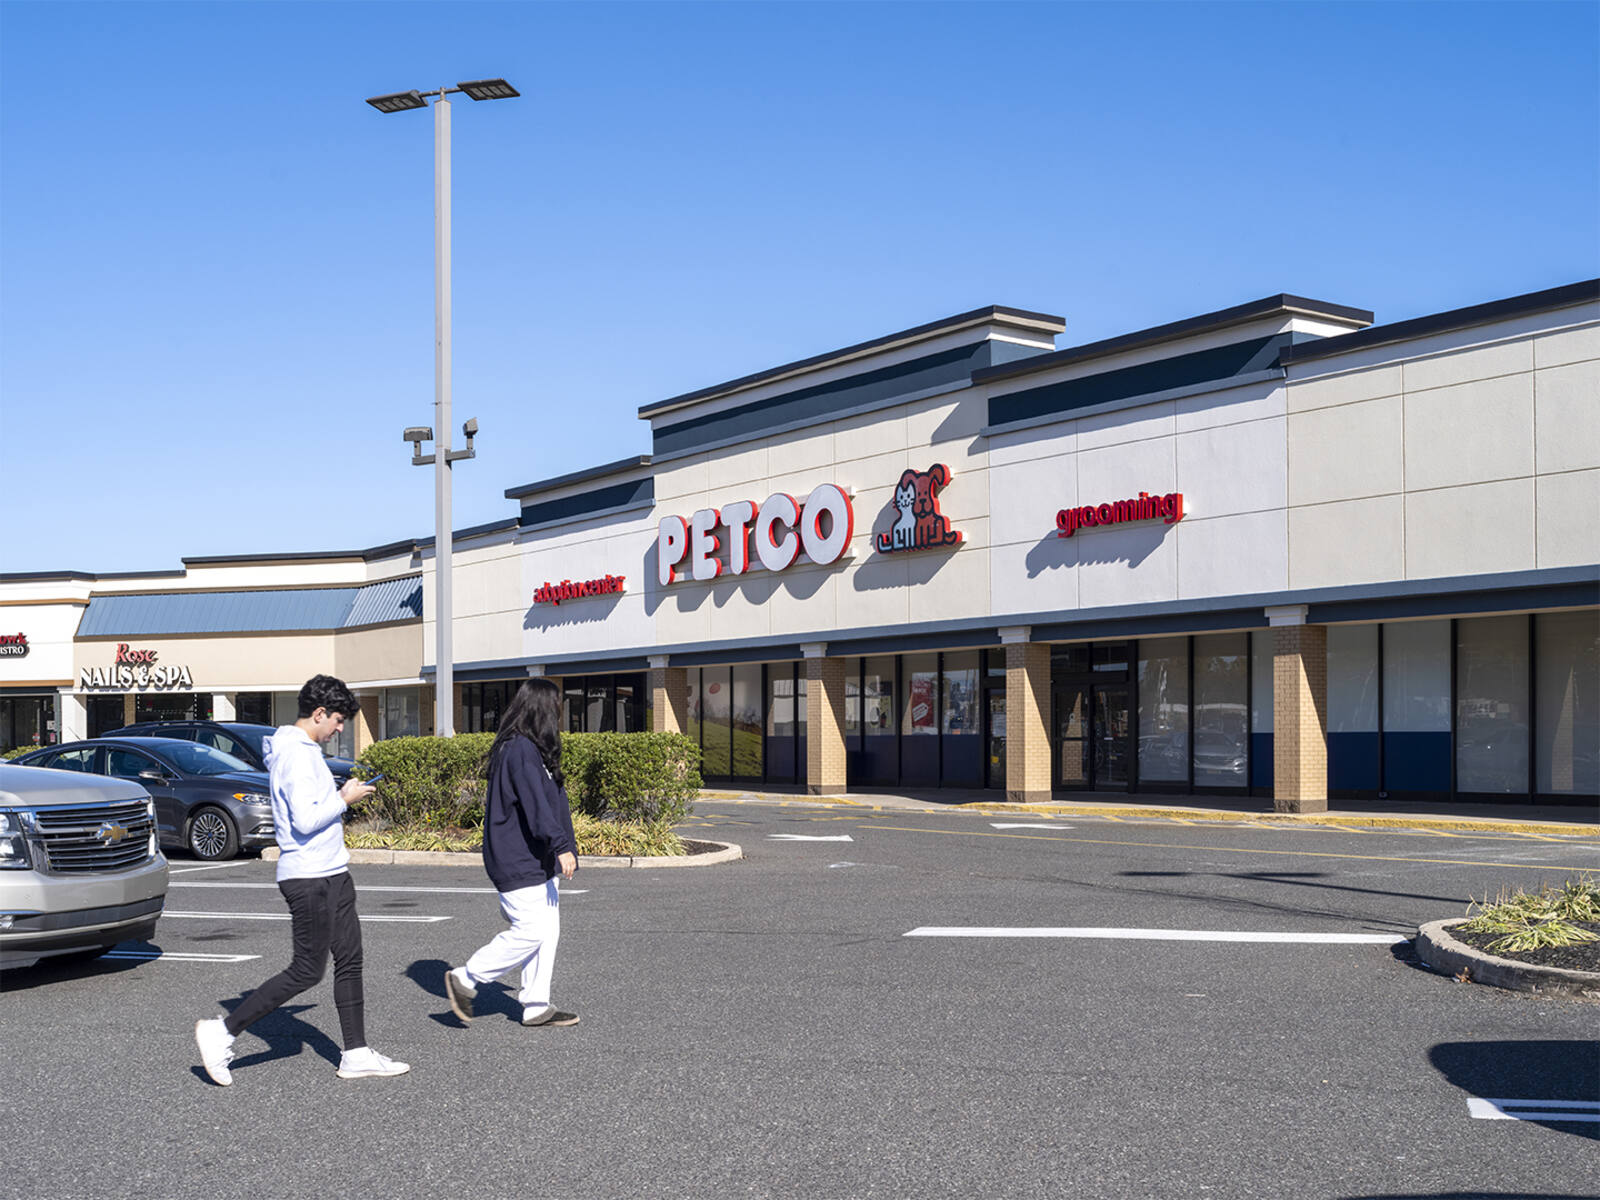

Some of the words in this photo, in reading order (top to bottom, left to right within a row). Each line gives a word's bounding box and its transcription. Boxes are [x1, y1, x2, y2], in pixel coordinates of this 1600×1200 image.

[1056, 491, 1183, 538] grooming
[658, 483, 854, 586] PETCO
[533, 579, 584, 606] adoption
[584, 574, 626, 597] center
[114, 642, 158, 665] Rose
[80, 666, 132, 687] NAILS
[138, 665, 150, 686] &
[154, 665, 193, 686] SPA
